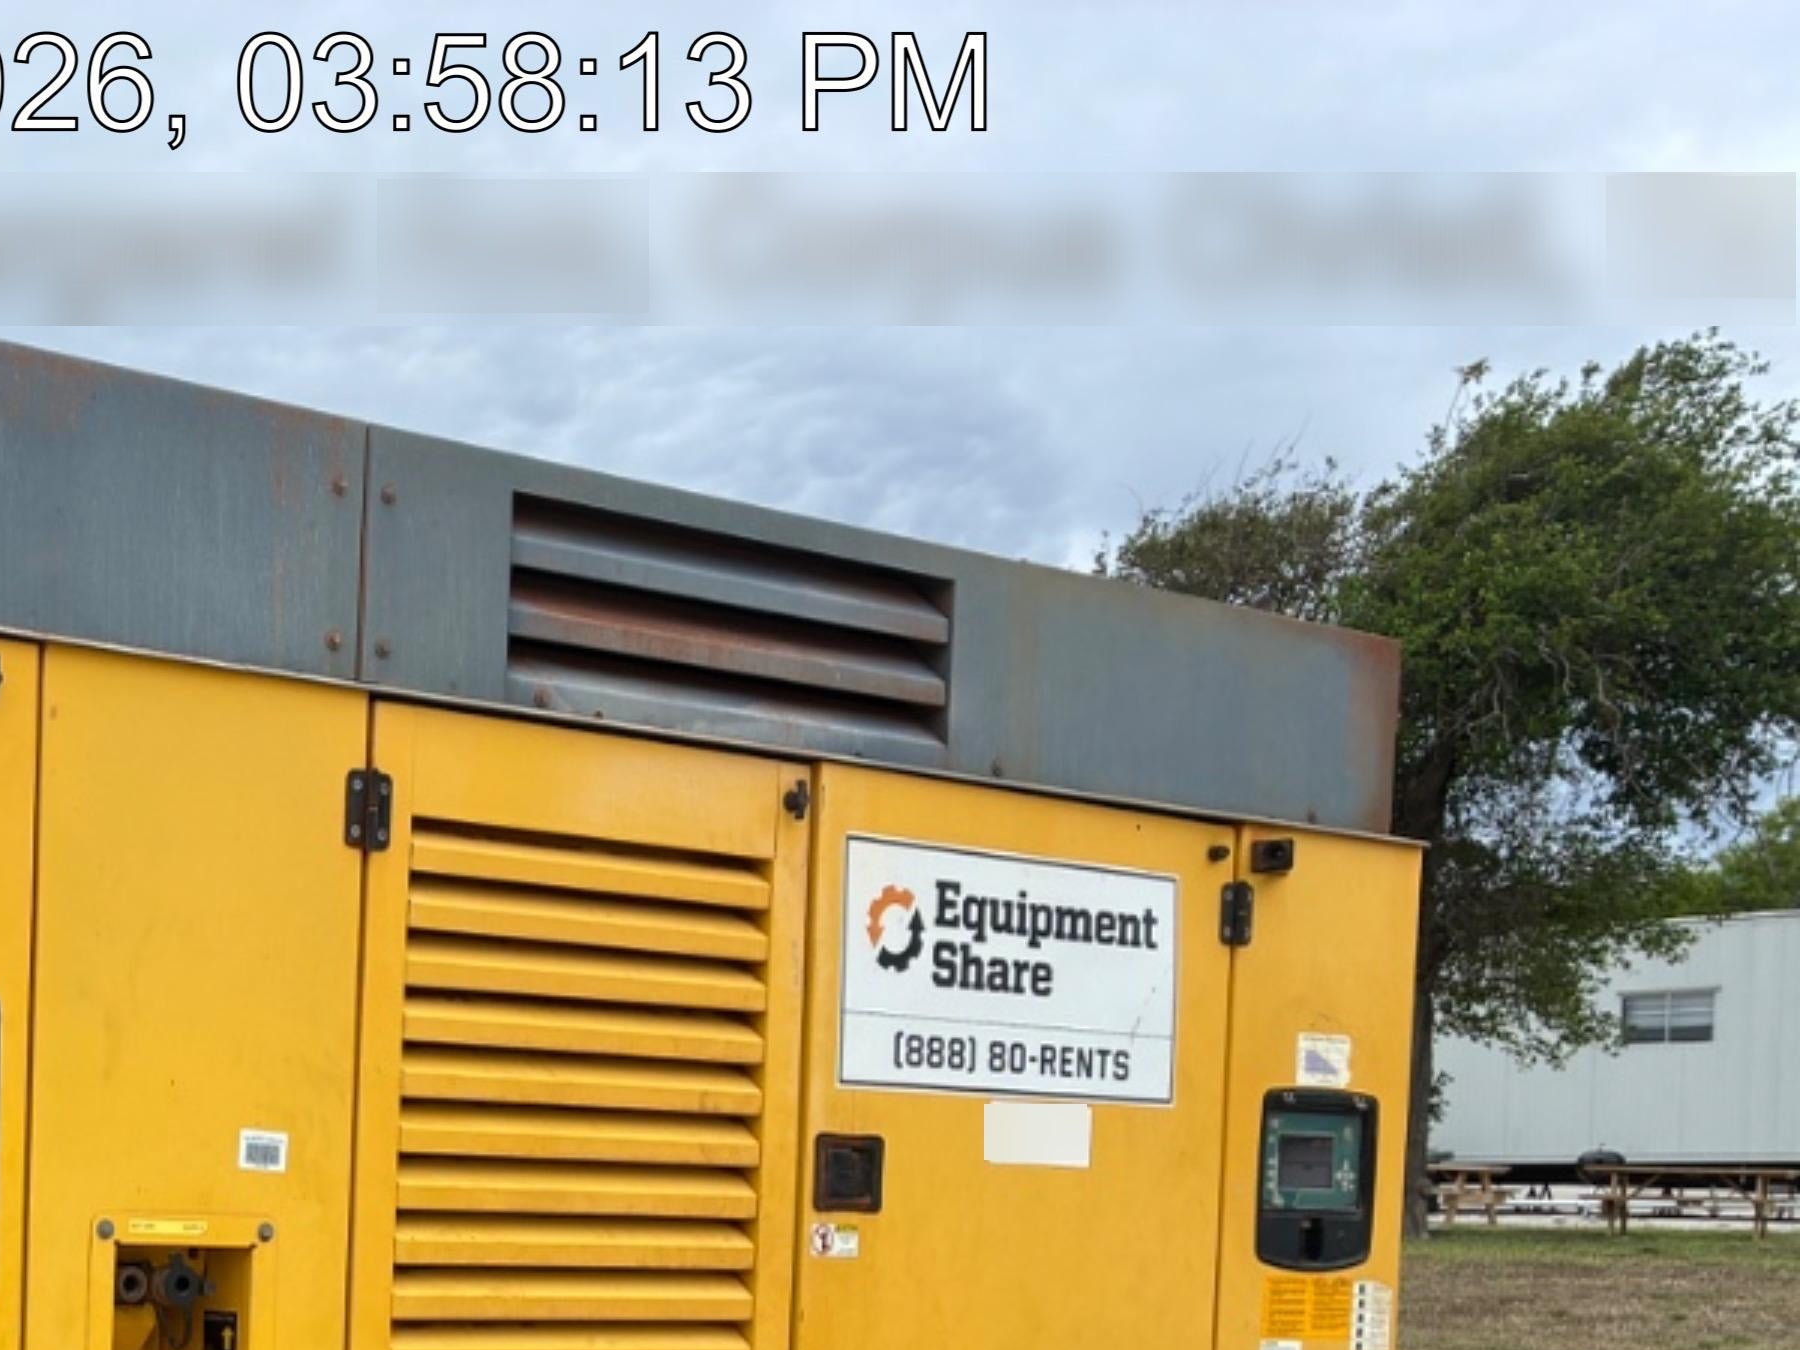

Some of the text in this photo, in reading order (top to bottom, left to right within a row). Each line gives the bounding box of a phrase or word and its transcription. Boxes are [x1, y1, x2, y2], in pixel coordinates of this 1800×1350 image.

[934, 881, 1157, 949] Equipment
[932, 941, 1053, 997] Share
[894, 1031, 1131, 1081] (888) 80-RENTS
